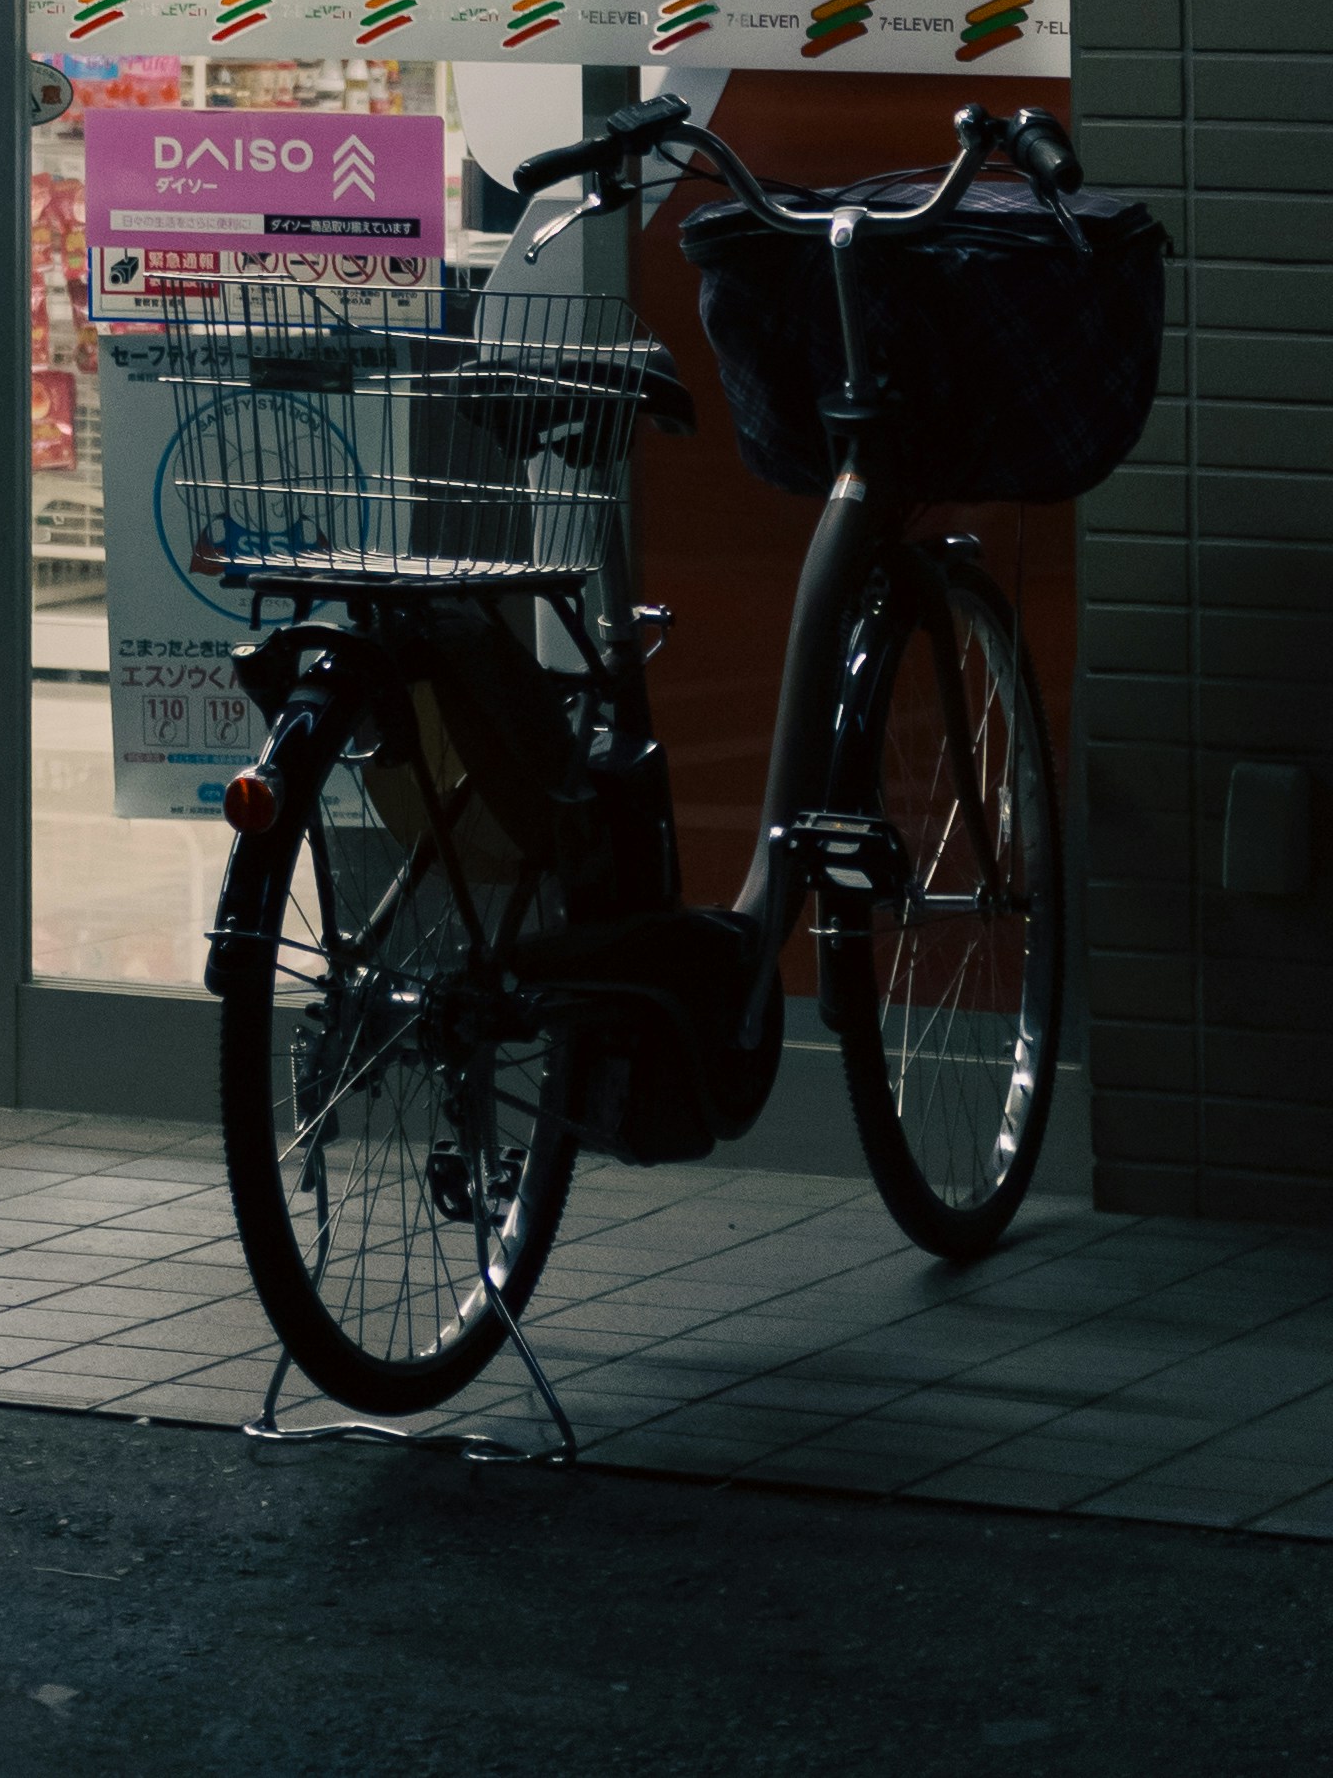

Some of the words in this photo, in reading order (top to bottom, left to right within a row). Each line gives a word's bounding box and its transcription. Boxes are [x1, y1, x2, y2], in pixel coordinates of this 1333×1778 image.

[155, 176, 218, 194] ダイソー
[270, 217, 413, 236] ダイソー商品取り揃えています
[119, 665, 241, 690] エスゾウく
[147, 699, 184, 720] 110
[208, 699, 246, 722] 119
